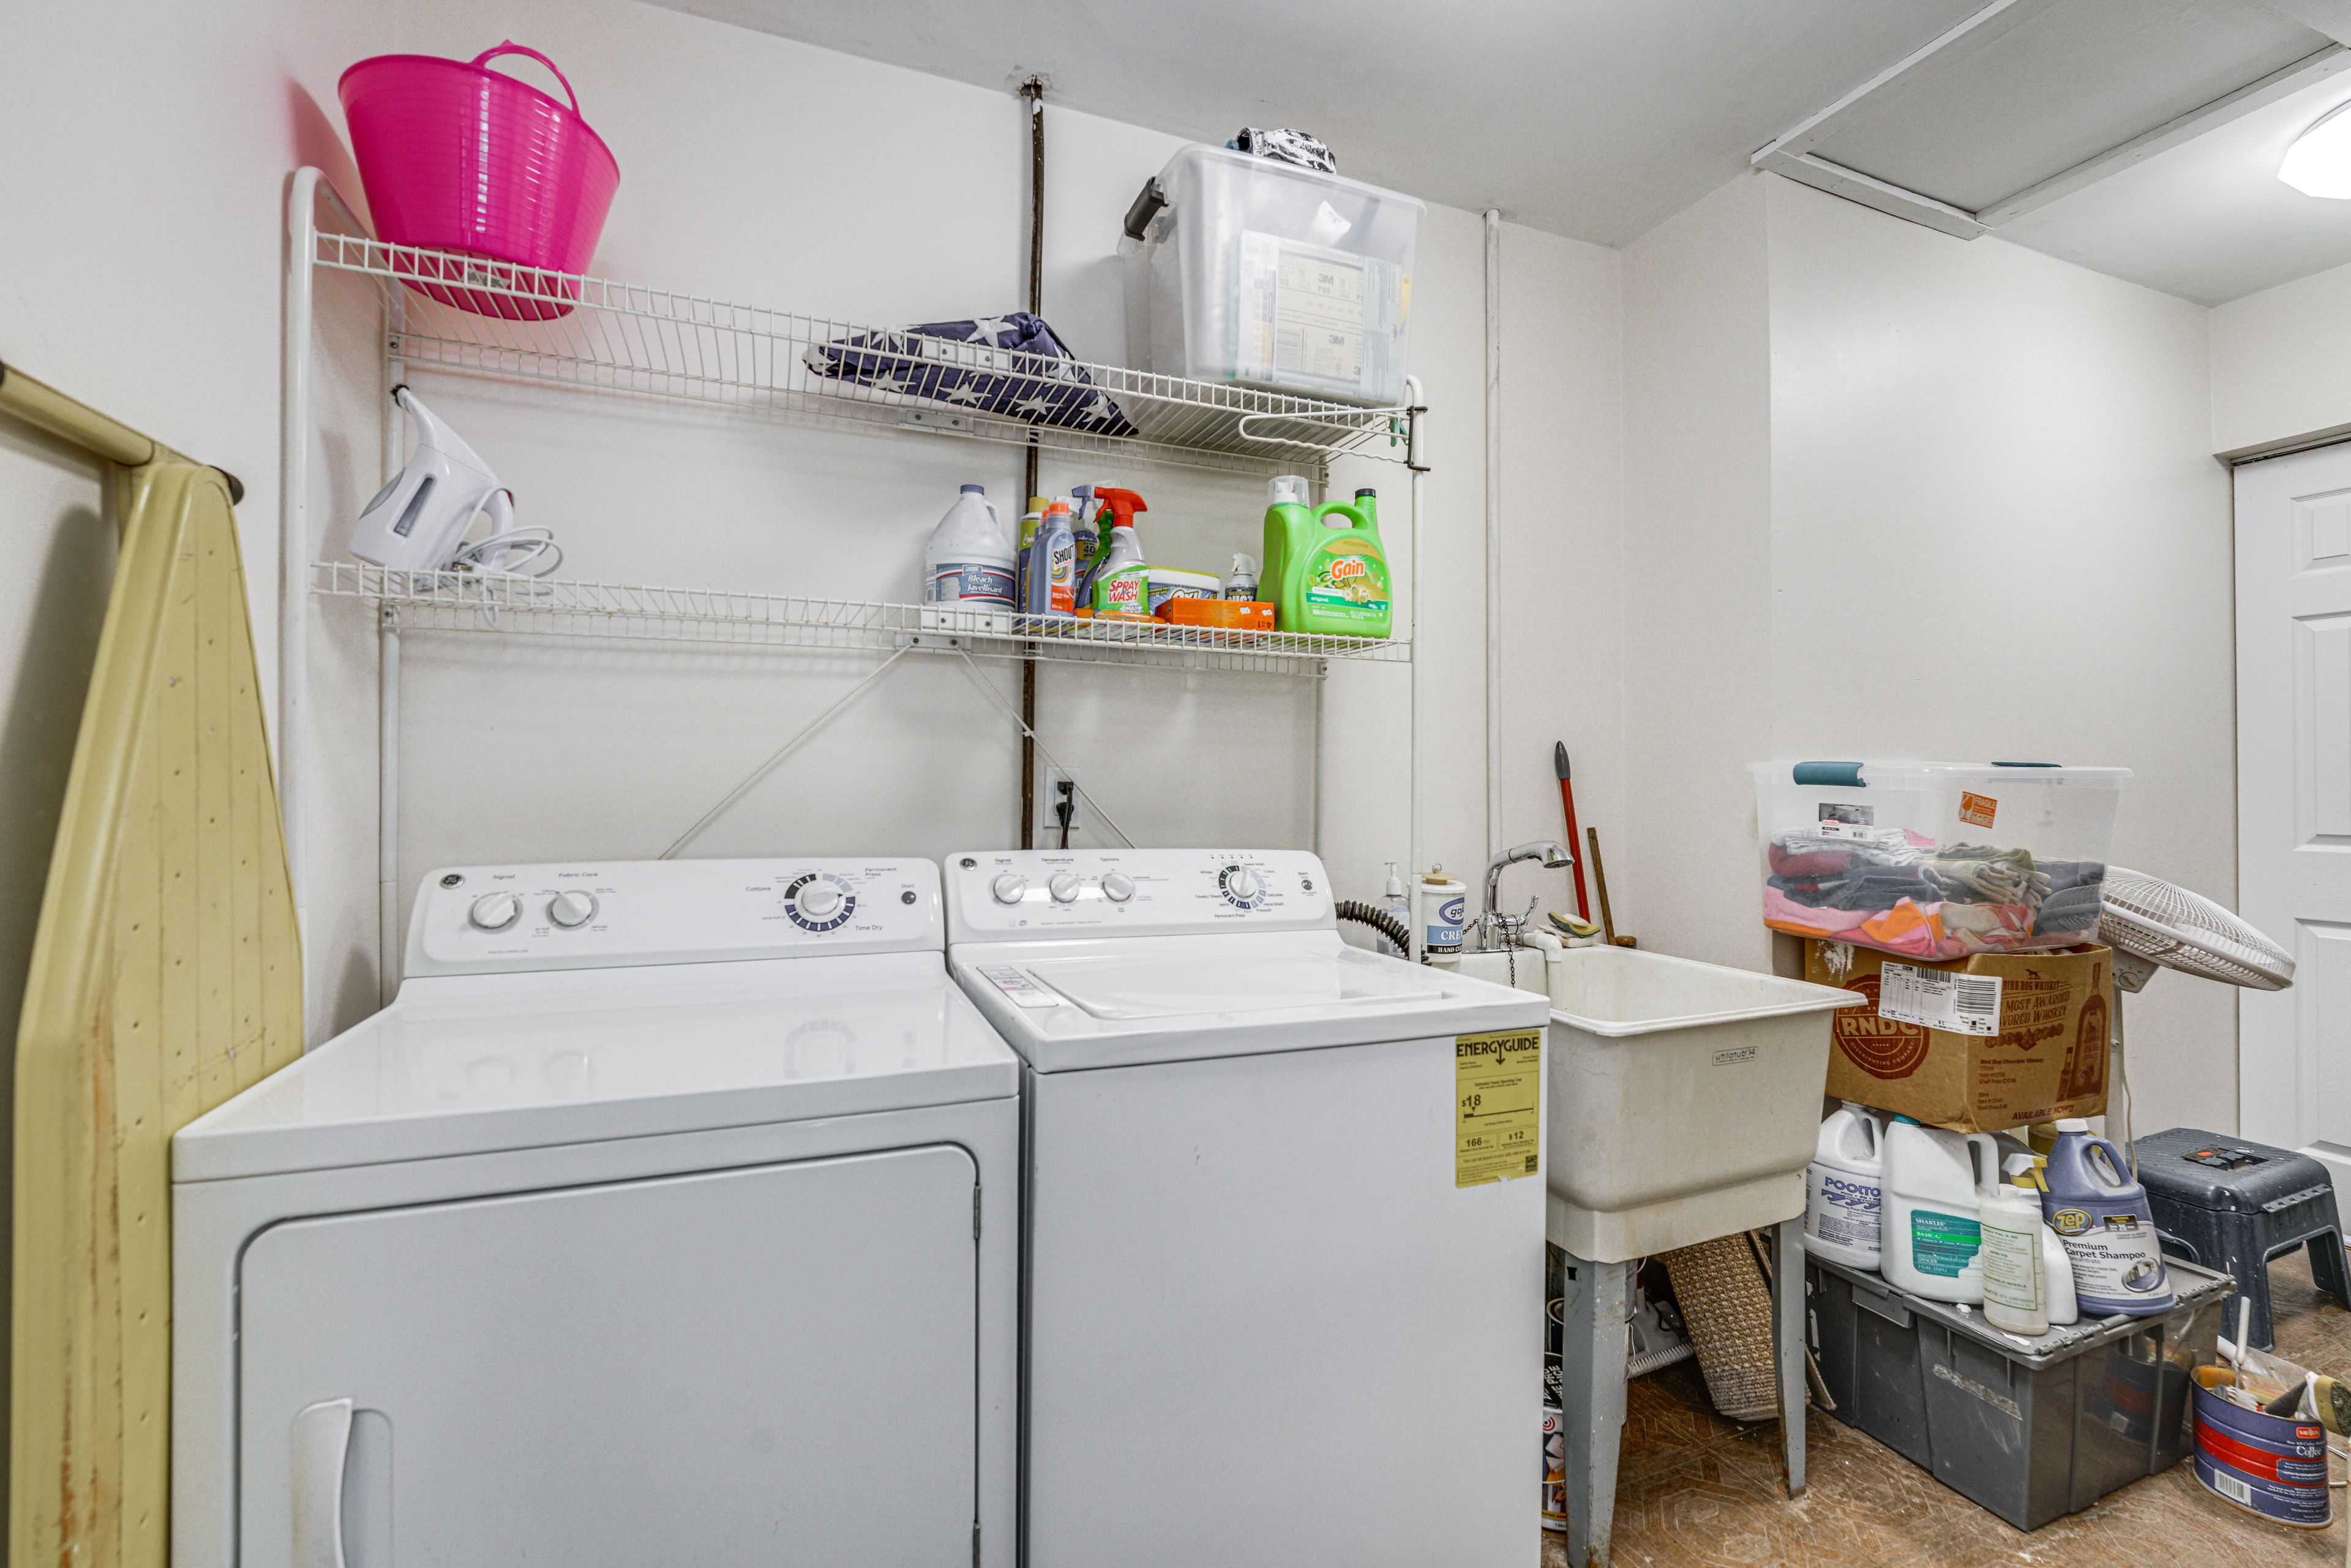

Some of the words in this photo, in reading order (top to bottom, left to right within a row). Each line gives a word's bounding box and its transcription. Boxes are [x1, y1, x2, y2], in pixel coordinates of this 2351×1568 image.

[1319, 274, 1333, 285] 3M
[1318, 285, 1331, 294] P80
[1329, 334, 1344, 346] 3M
[1054, 544, 1074, 565] SHOUT
[1332, 559, 1364, 579] Gain
[968, 574, 993, 583] Bleach
[967, 583, 1003, 593] Javellisant
[1109, 580, 1140, 592] SPRAY
[1109, 591, 1138, 602] WASH
[1974, 797, 1997, 809] FRAGILE
[1441, 929, 1463, 940] CRE
[2020, 980, 2033, 991] DOG
[2006, 999, 2031, 1013] MOST
[2033, 991, 2071, 1010] AWARDED
[2034, 1005, 2068, 1022] WHISKEY
[1841, 1017, 1919, 1036] RNDC
[1457, 1037, 1539, 1057] ENERGYGUIDE
[1850, 1041, 1891, 1065] DISTRIBUTING
[1892, 1041, 1914, 1064] COMPANY
[1462, 1095, 1481, 1107] $18
[2012, 1107, 2052, 1121] AVAILABLE
[1466, 1138, 1482, 1147] 166
[2057, 1214, 2086, 1229] zep
[2063, 1239, 2108, 1251] Premium
[2065, 1247, 2097, 1258] Carpet
[2099, 1252, 2146, 1261] Shampoo
[2297, 1446, 2322, 1458] Coffee
